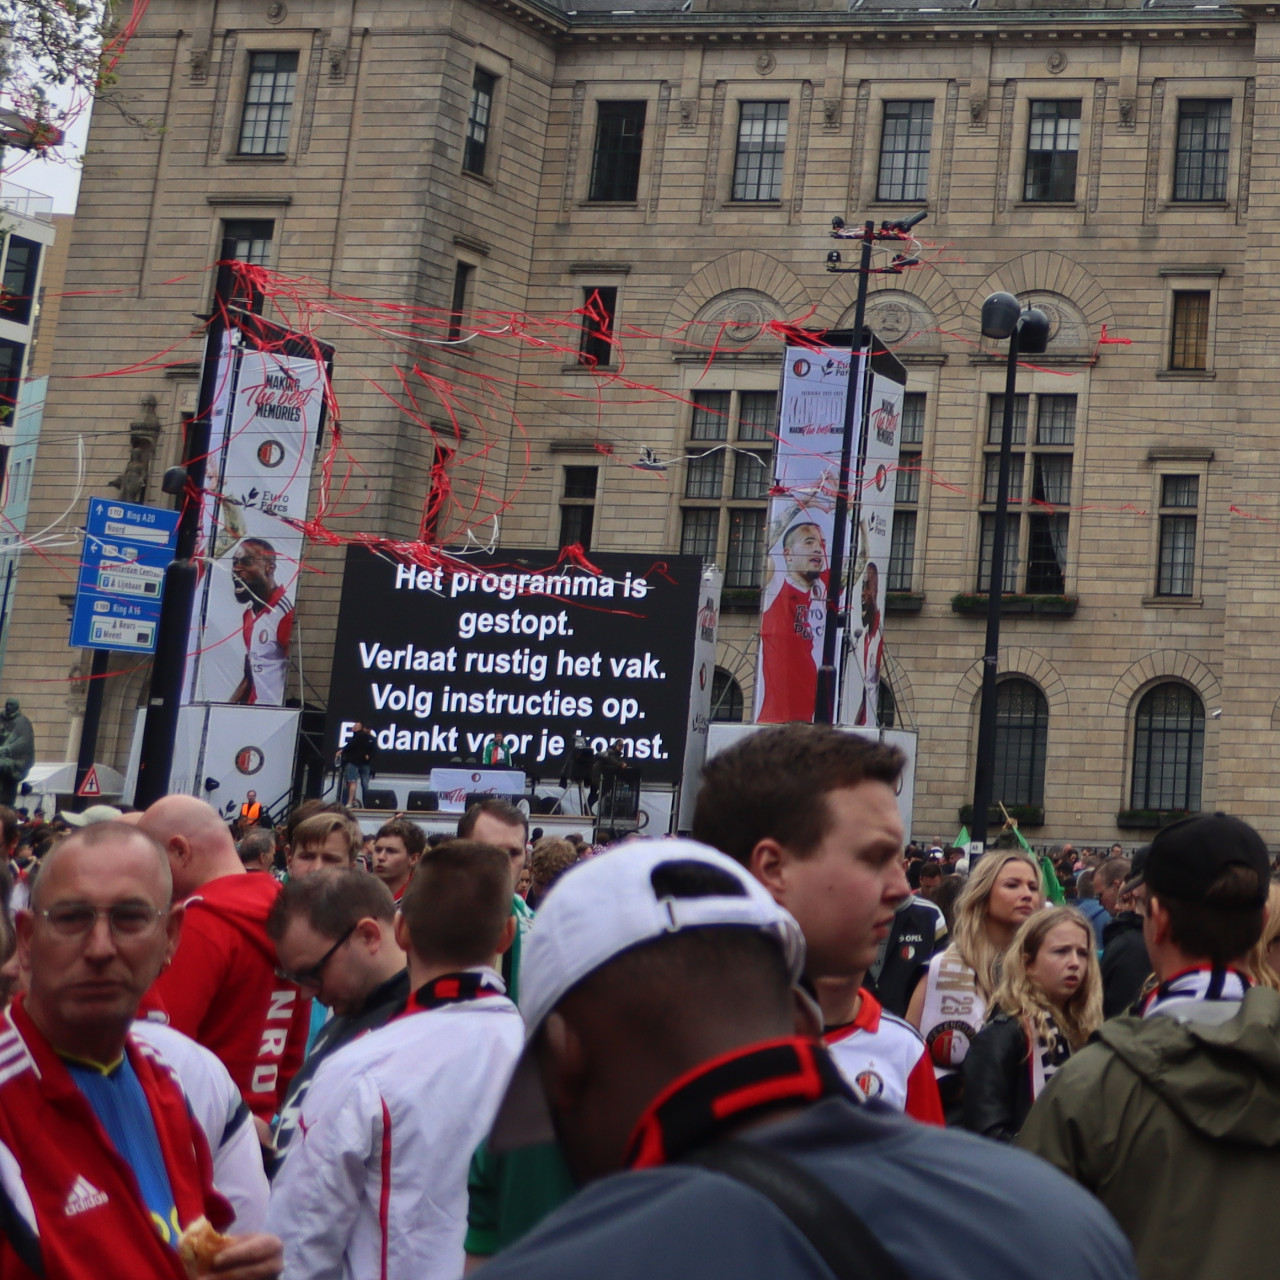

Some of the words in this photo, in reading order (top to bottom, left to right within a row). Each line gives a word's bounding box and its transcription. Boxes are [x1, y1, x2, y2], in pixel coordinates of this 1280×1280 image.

[241, 383, 275, 406] The
[278, 387, 319, 408] best
[255, 404, 301, 422] MEMORIES
[260, 501, 288, 512] Parcs
[262, 490, 289, 503] Euro
[126, 510, 140, 522] Ring
[142, 514, 156, 523] A20
[107, 523, 126, 533] Noord
[395, 564, 443, 591] Het
[451, 569, 614, 600] programma
[622, 572, 648, 599] is
[112, 604, 126, 615] Ring
[458, 608, 574, 641] gestopt.
[359, 642, 457, 672] Verlaat
[464, 649, 547, 682] rustig
[557, 650, 601, 677] het
[610, 653, 666, 679] vak.
[371, 683, 433, 718] Volg
[441, 686, 593, 717] instructies
[602, 696, 646, 725] op.
[339, 722, 458, 753] Bdankt
[537, 729, 565, 762] je
[905, 934, 923, 943] OPEL
[65, 1190, 109, 1216] adidas
